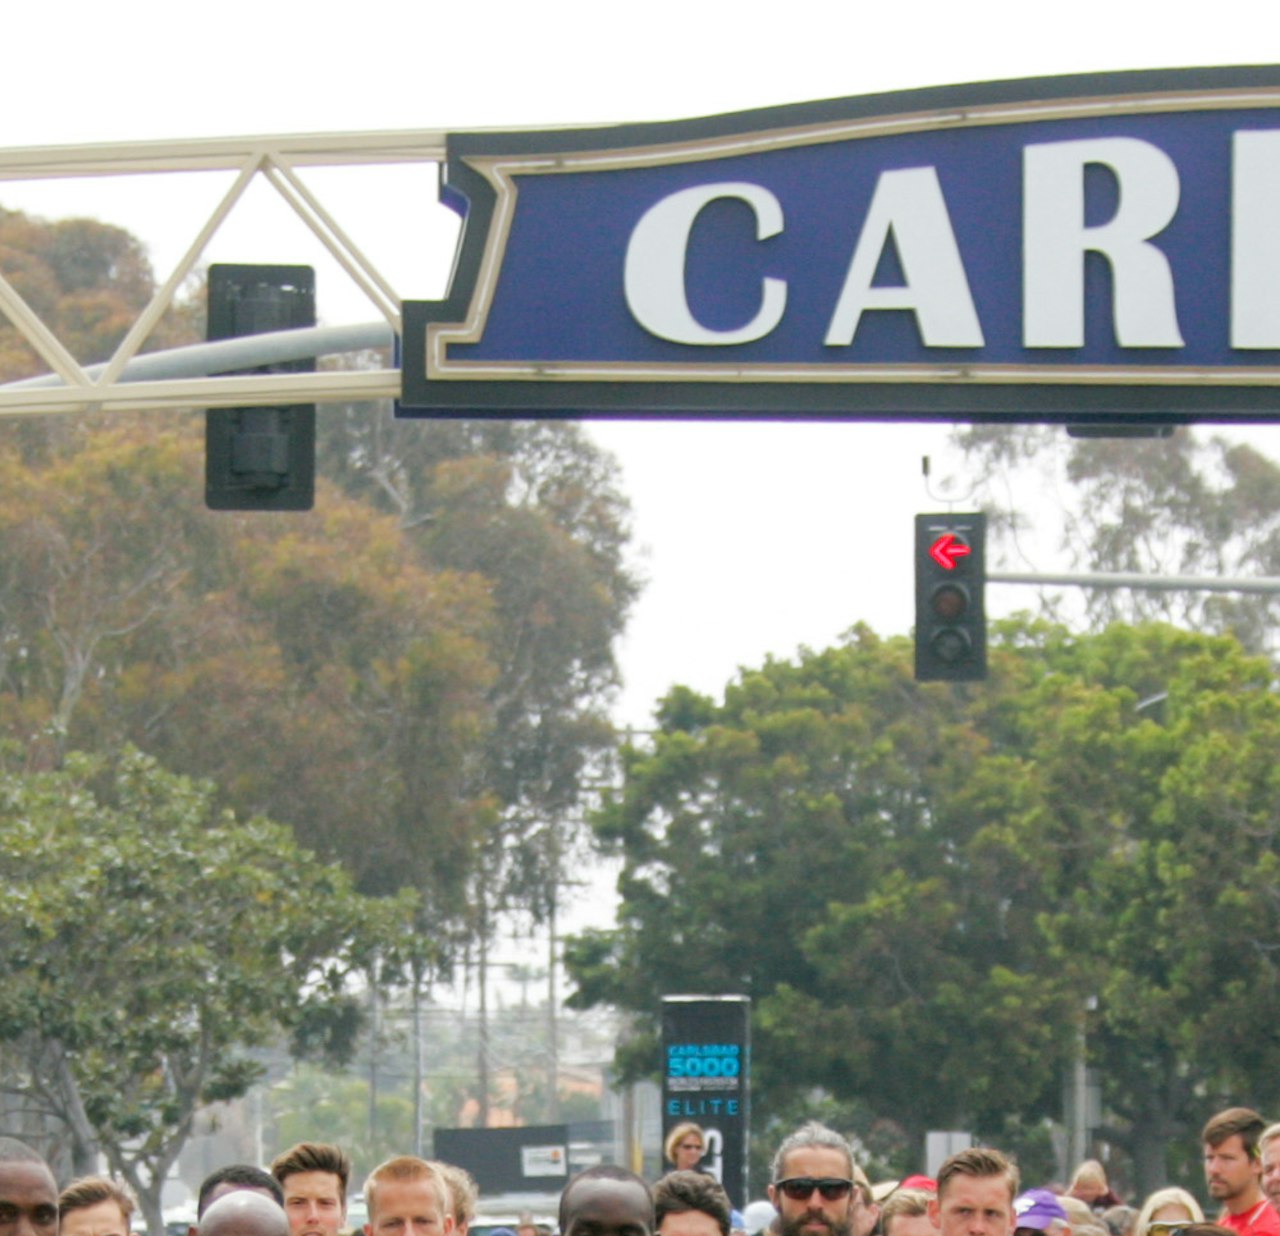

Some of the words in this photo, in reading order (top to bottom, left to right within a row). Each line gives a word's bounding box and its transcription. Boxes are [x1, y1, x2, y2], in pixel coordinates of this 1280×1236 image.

[667, 1044, 740, 1056] CARLSBAD
[667, 1056, 741, 1078] 5000
[667, 1099, 739, 1115] ELITE
